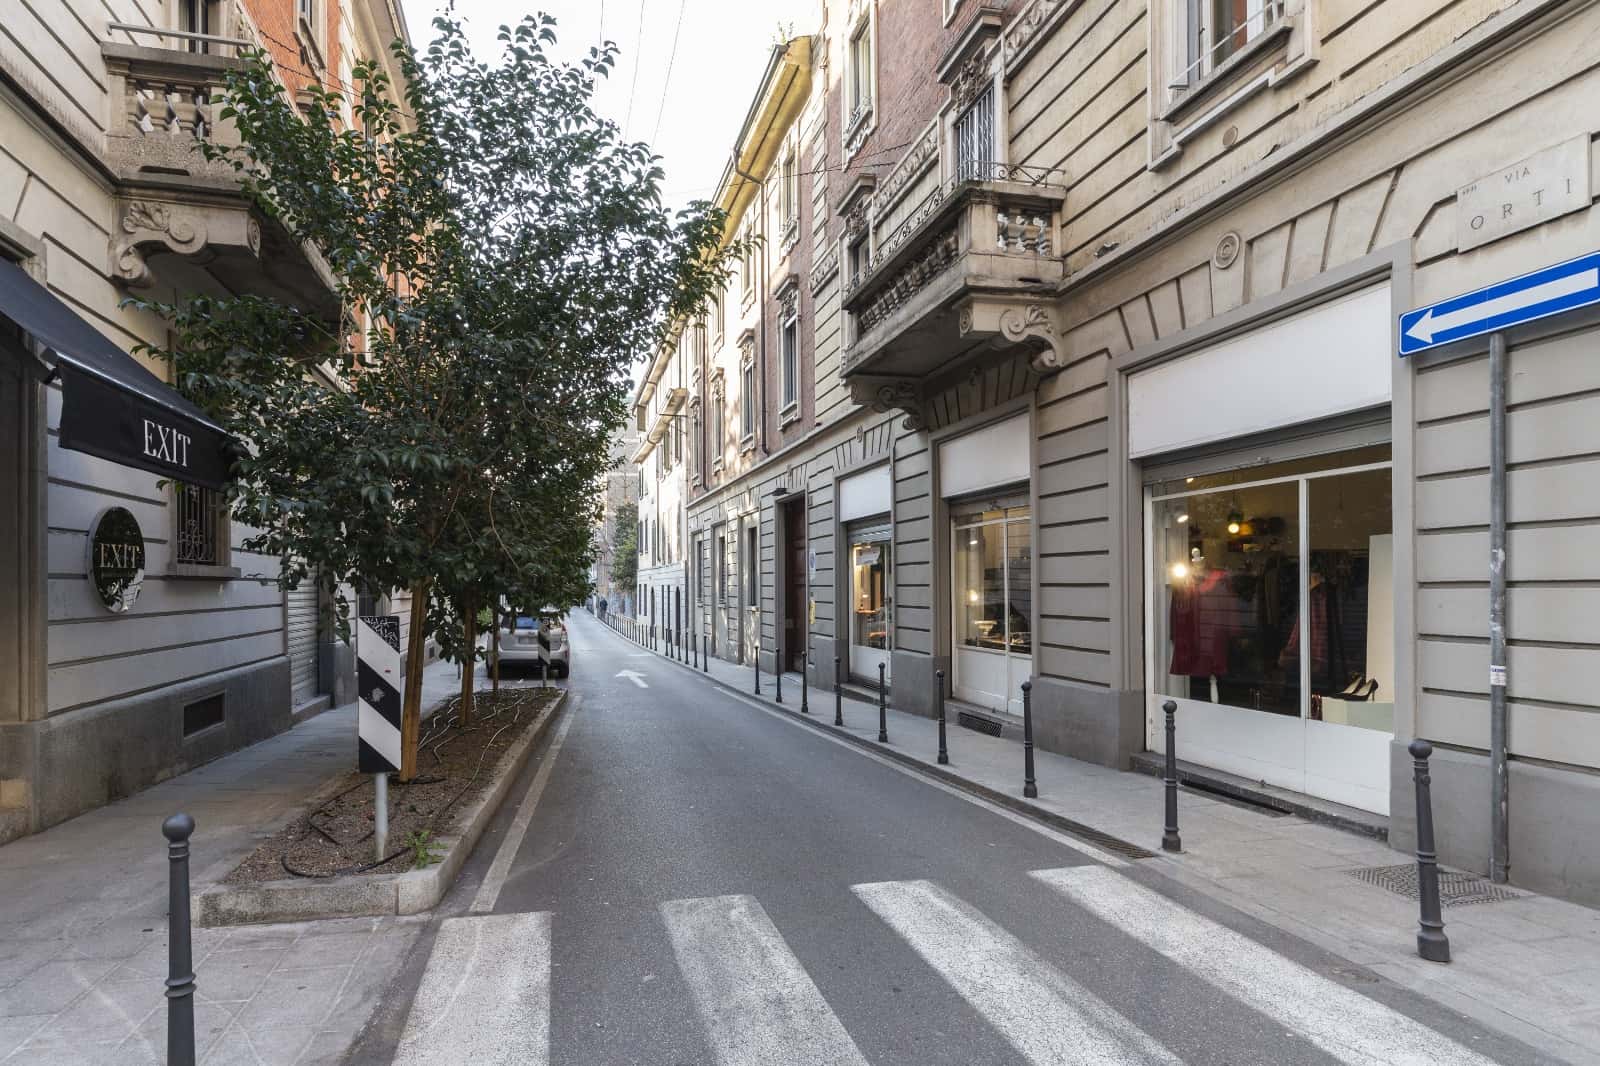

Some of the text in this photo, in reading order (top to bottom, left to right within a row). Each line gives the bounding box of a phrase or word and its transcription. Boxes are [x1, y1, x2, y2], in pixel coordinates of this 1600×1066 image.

[1504, 167, 1530, 184] VIA
[1470, 178, 1571, 230] ORTI
[143, 419, 191, 467] EXIT
[99, 543, 140, 569] EXIT
